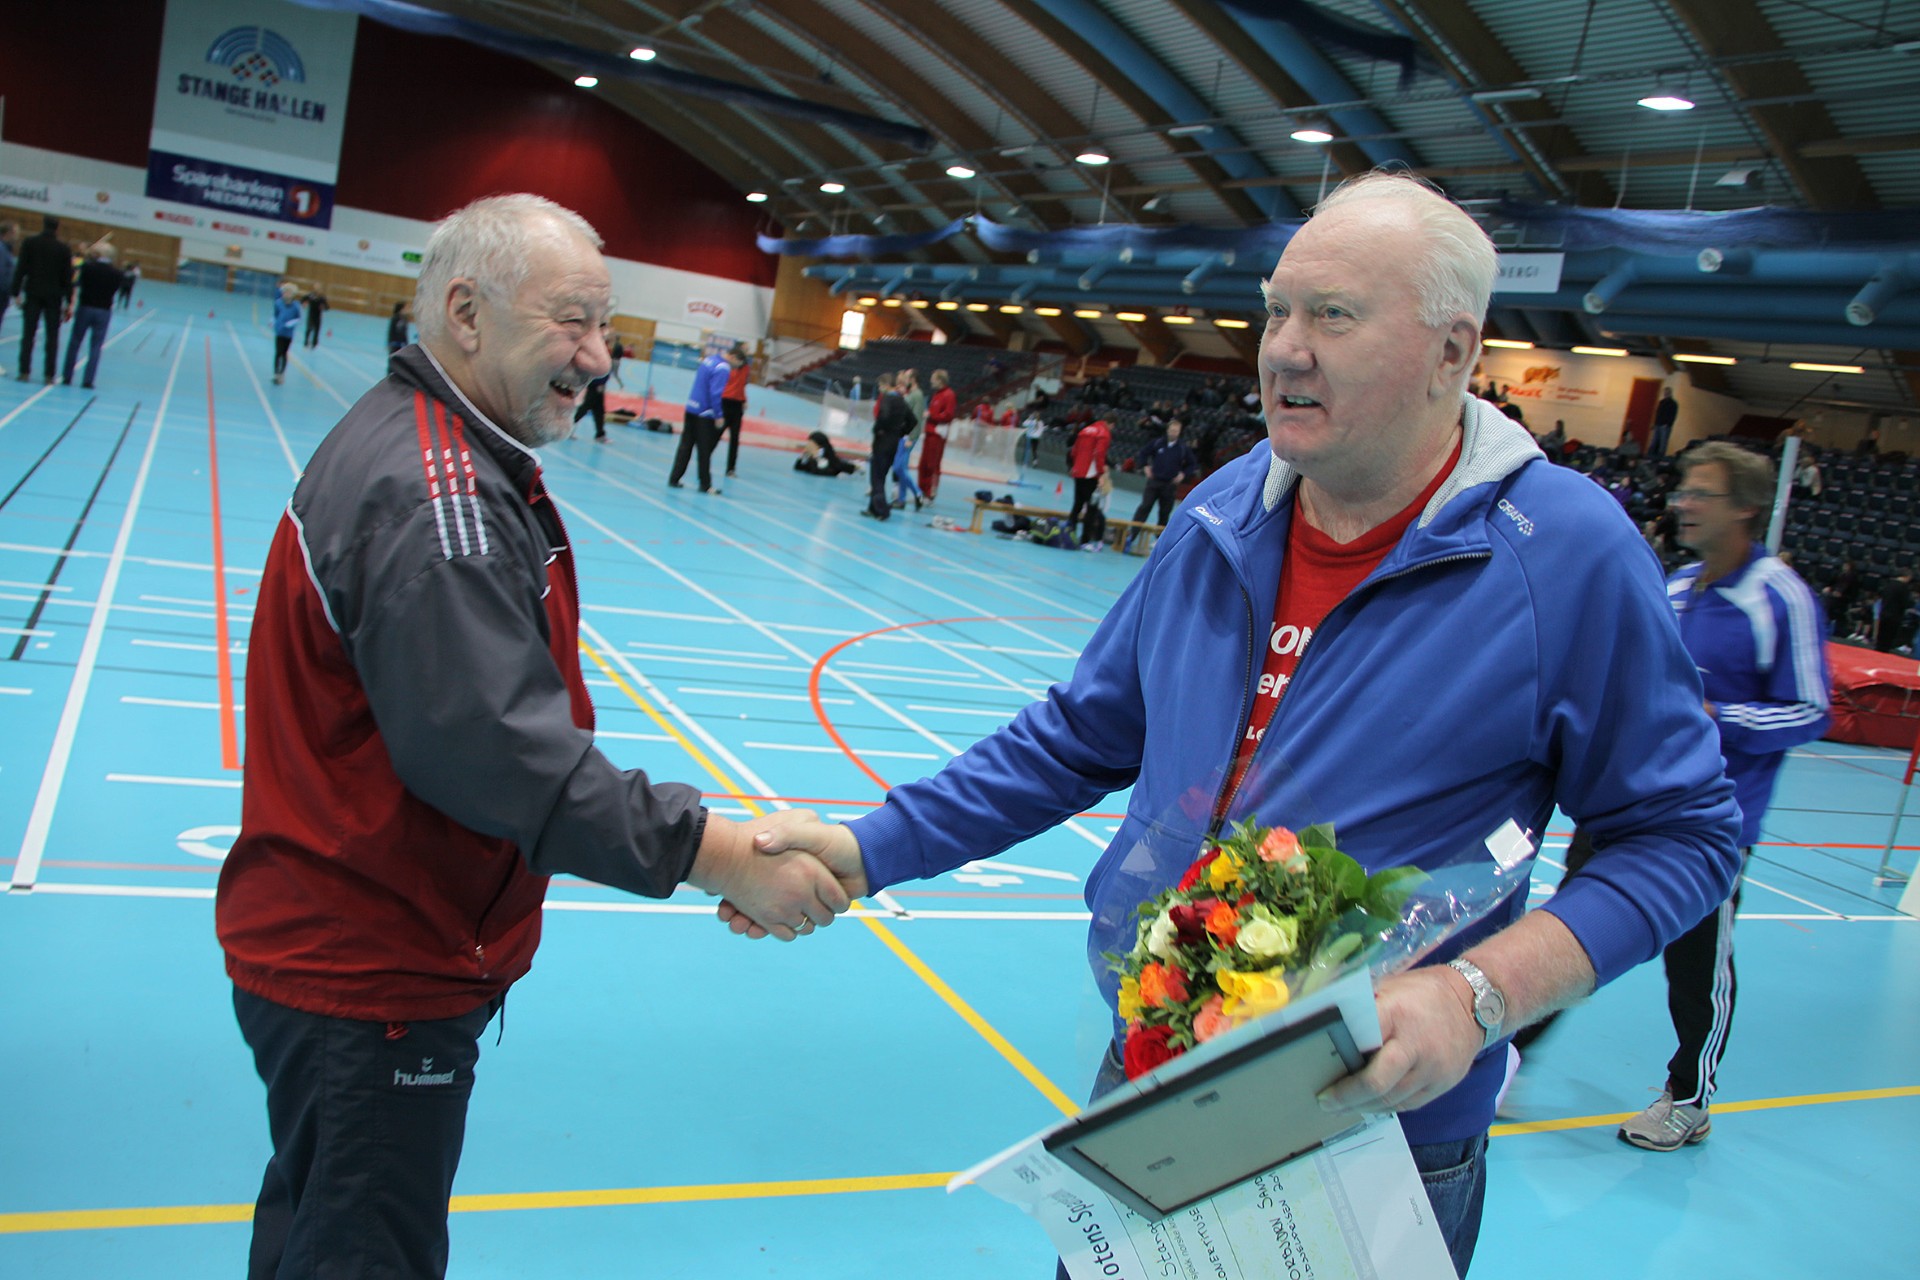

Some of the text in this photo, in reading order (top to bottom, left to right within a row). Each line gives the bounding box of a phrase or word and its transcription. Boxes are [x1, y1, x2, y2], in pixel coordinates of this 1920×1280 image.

[177, 73, 252, 108] STANGE
[296, 191, 311, 213] 1
[1497, 498, 1530, 527] CRAFT
[393, 1069, 456, 1086] hummel
[1082, 1223, 1125, 1280] otens
